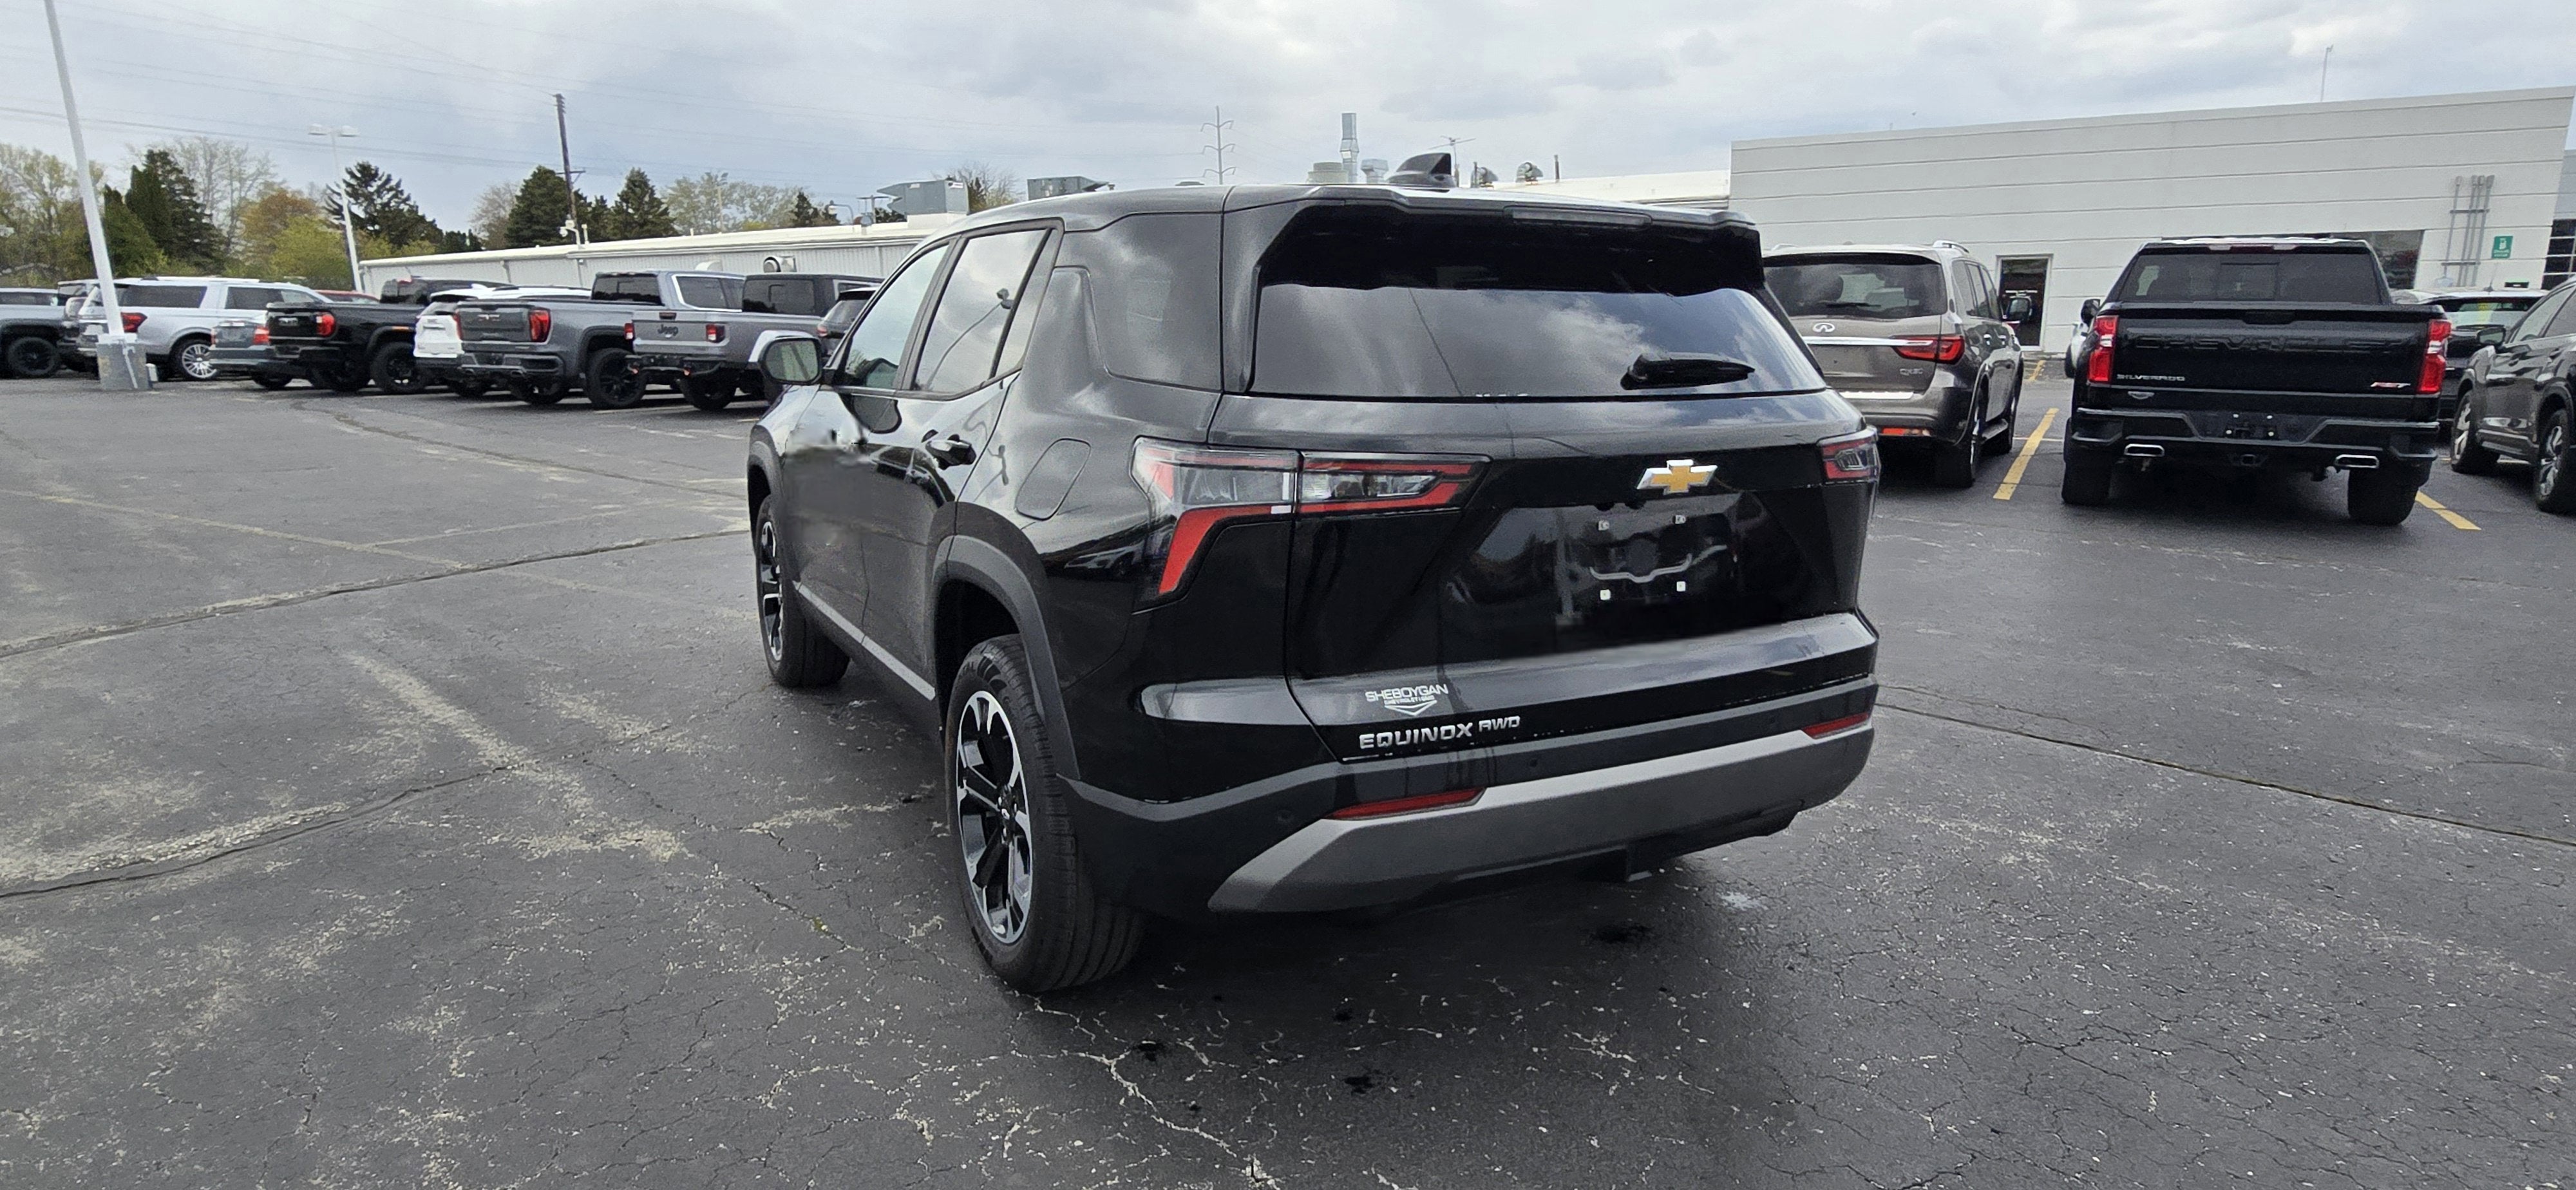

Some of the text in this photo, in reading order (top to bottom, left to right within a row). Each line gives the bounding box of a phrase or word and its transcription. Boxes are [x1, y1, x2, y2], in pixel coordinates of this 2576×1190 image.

[657, 323, 679, 336] Jeep
[2116, 373, 2186, 382] SILVERADO
[1365, 683, 1449, 703] SHEBOYGAN
[1359, 715, 1520, 750] EQUINOX AWD
